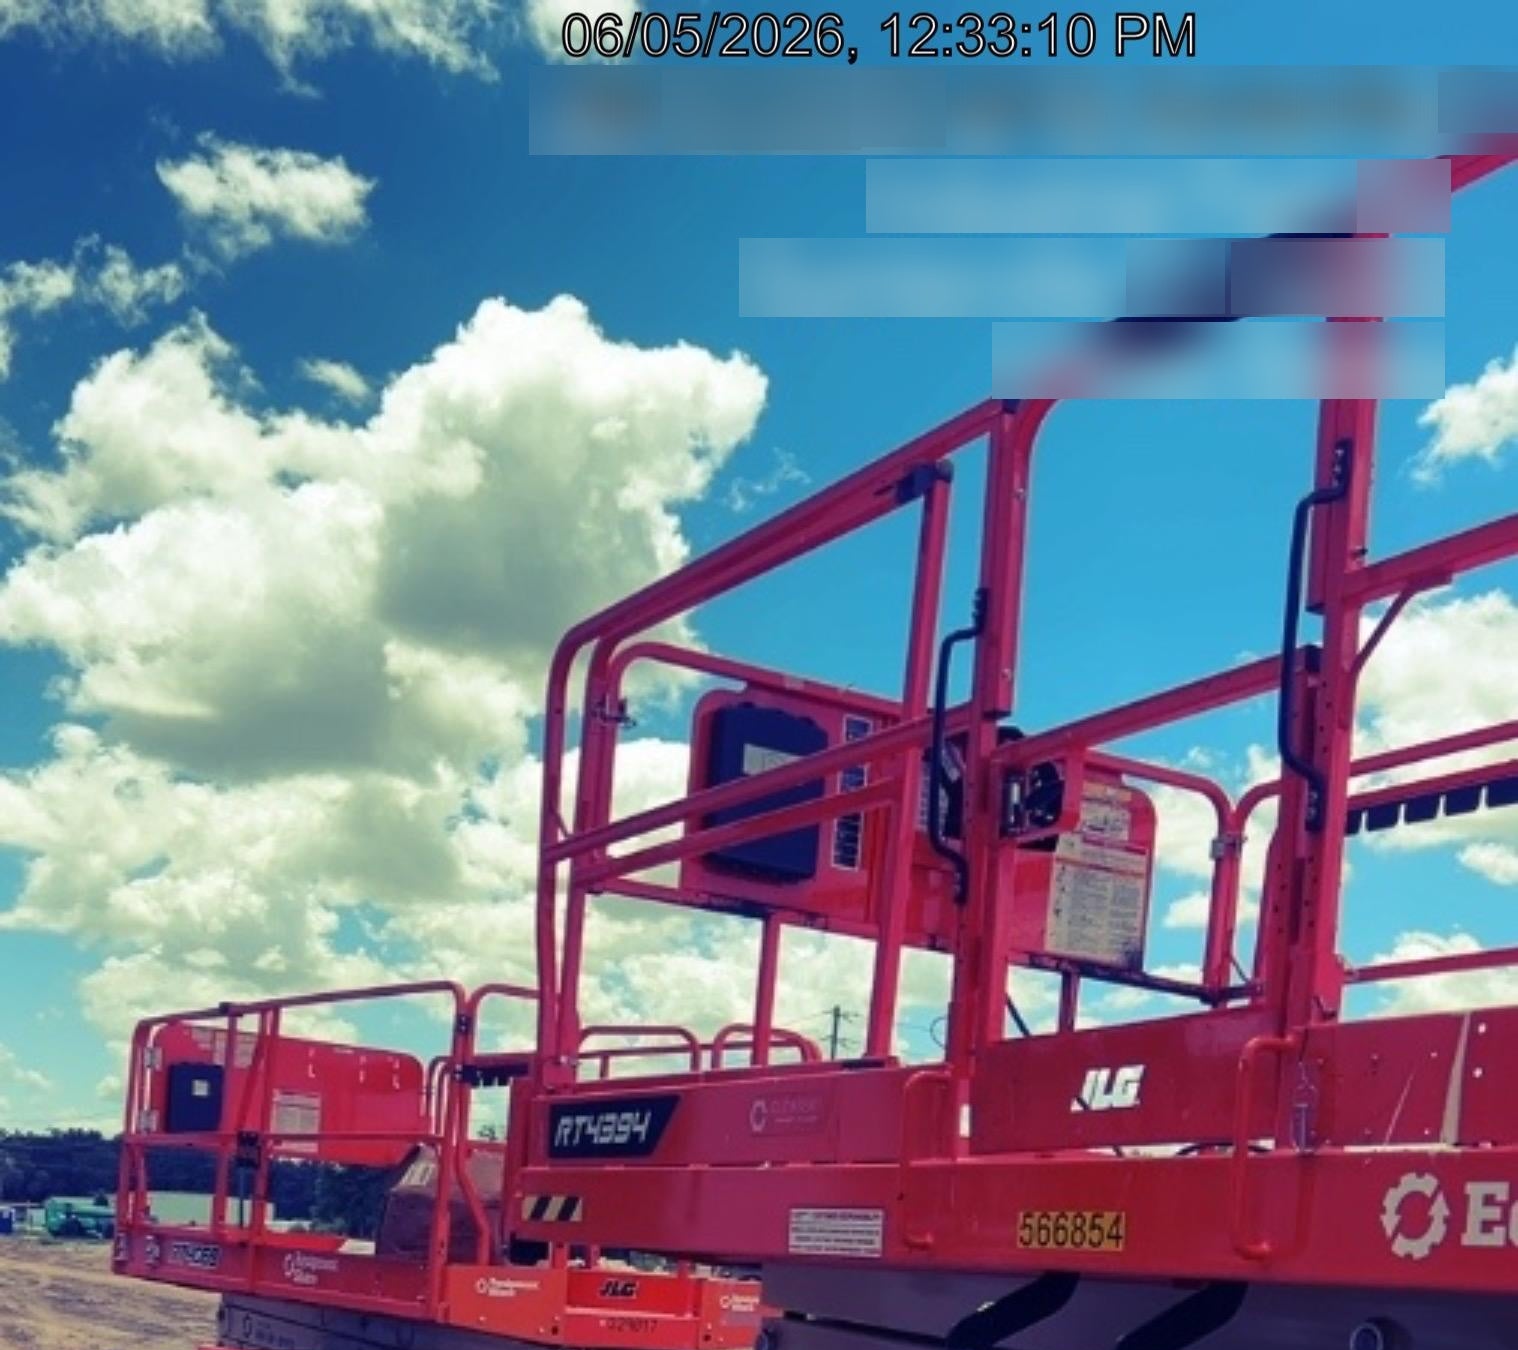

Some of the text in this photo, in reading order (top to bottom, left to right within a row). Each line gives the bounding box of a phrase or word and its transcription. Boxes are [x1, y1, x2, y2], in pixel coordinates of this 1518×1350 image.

[1071, 1064, 1145, 1112] JLG
[554, 1111, 651, 1147] RT4394
[1019, 1211, 1123, 1248] 566854
